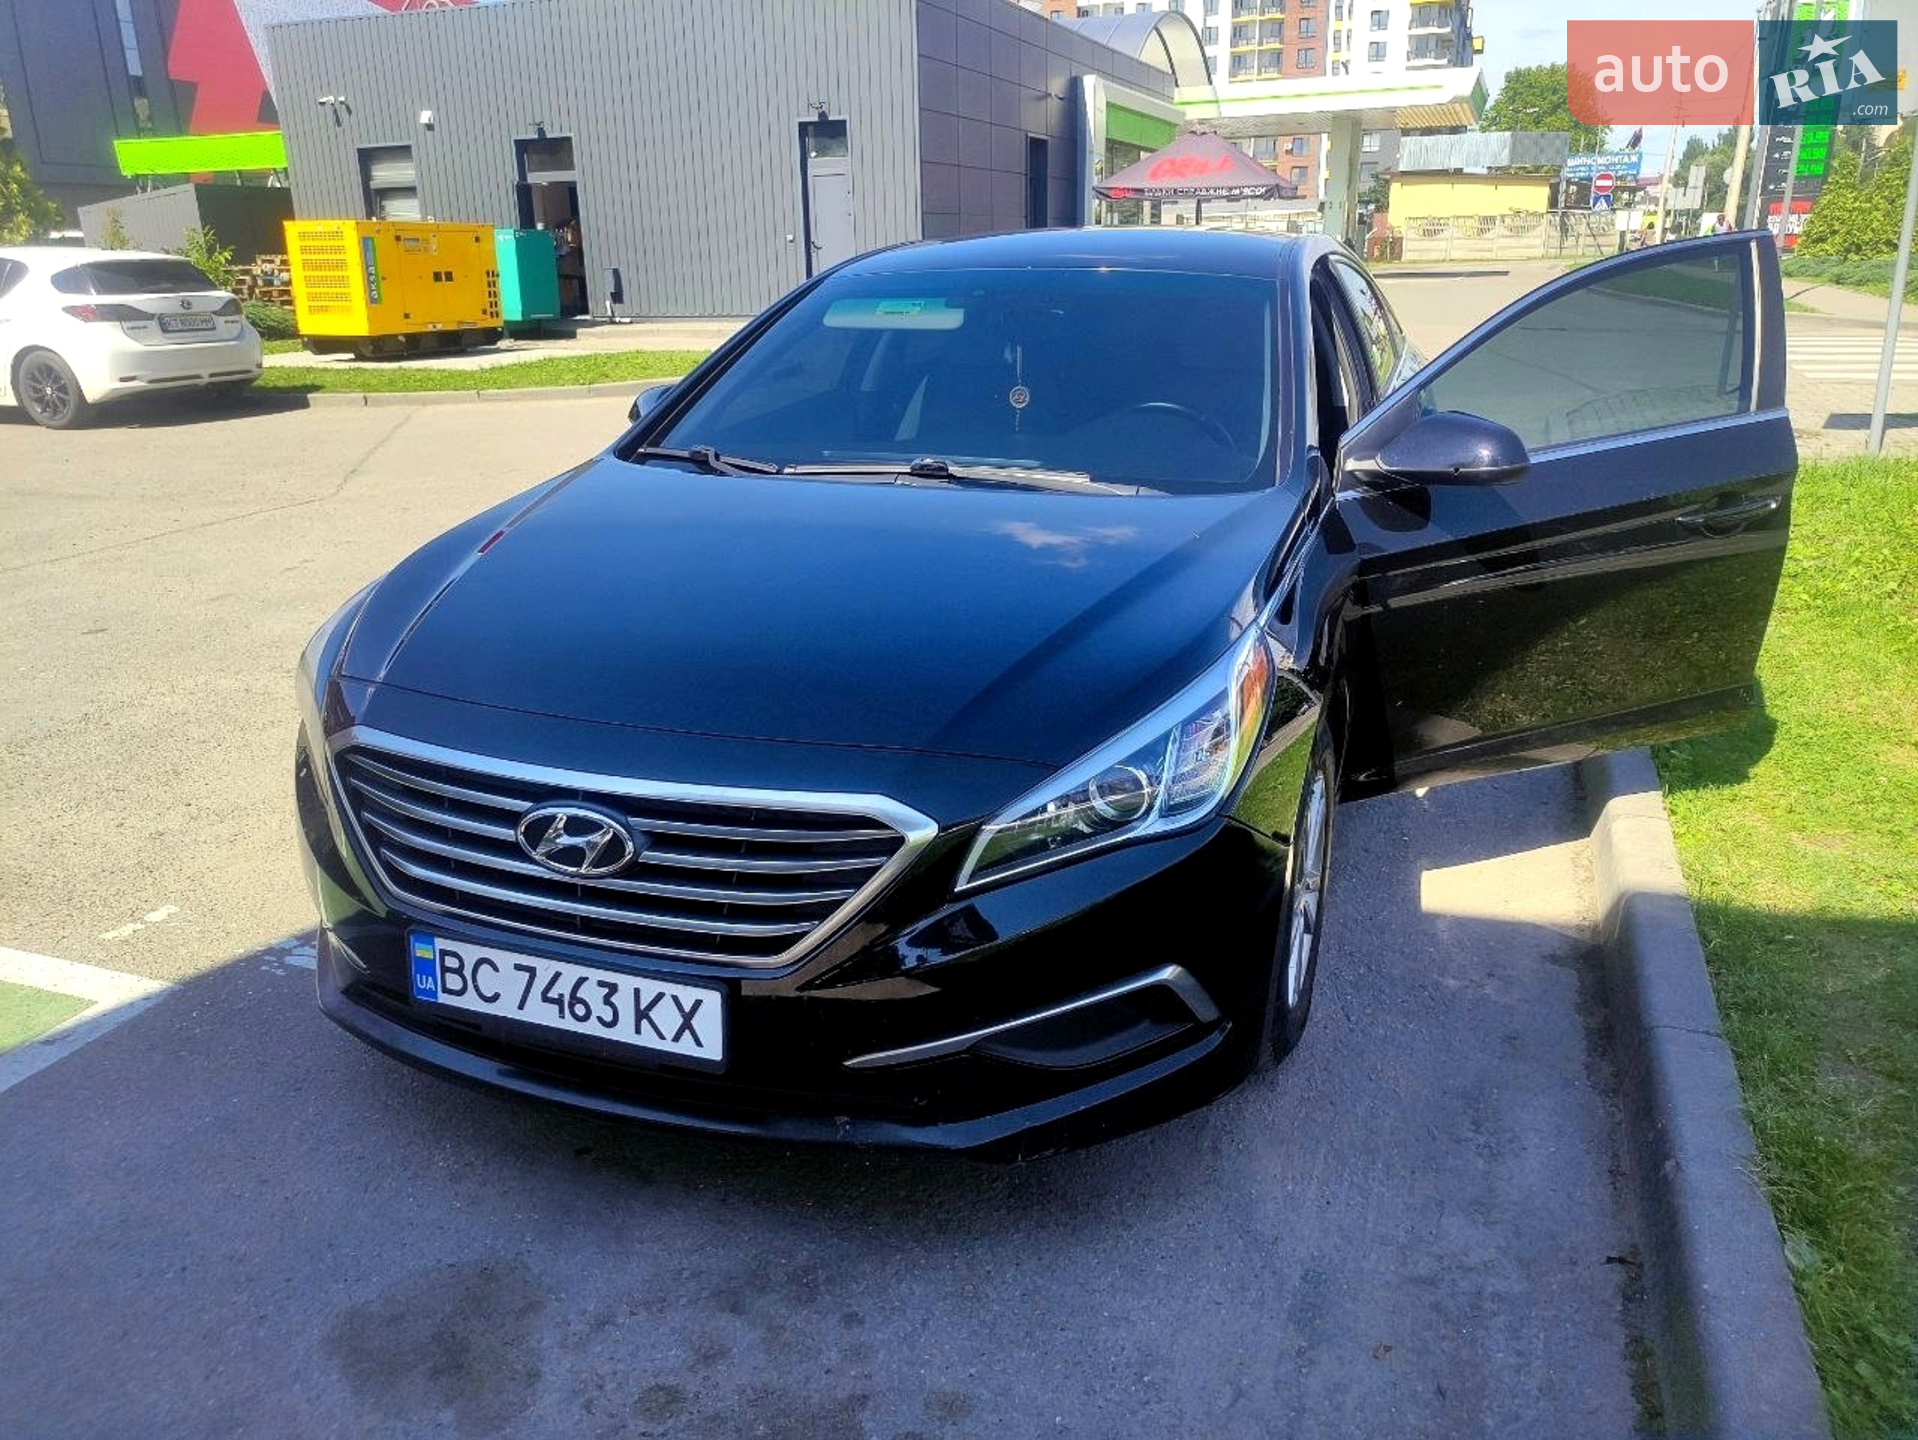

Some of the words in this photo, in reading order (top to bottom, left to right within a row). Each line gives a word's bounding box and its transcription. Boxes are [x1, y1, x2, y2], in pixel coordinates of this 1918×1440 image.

[416, 973, 435, 992] UA
[439, 948, 502, 1004] BC
[513, 963, 620, 1029] 7463
[633, 986, 704, 1048] KX
